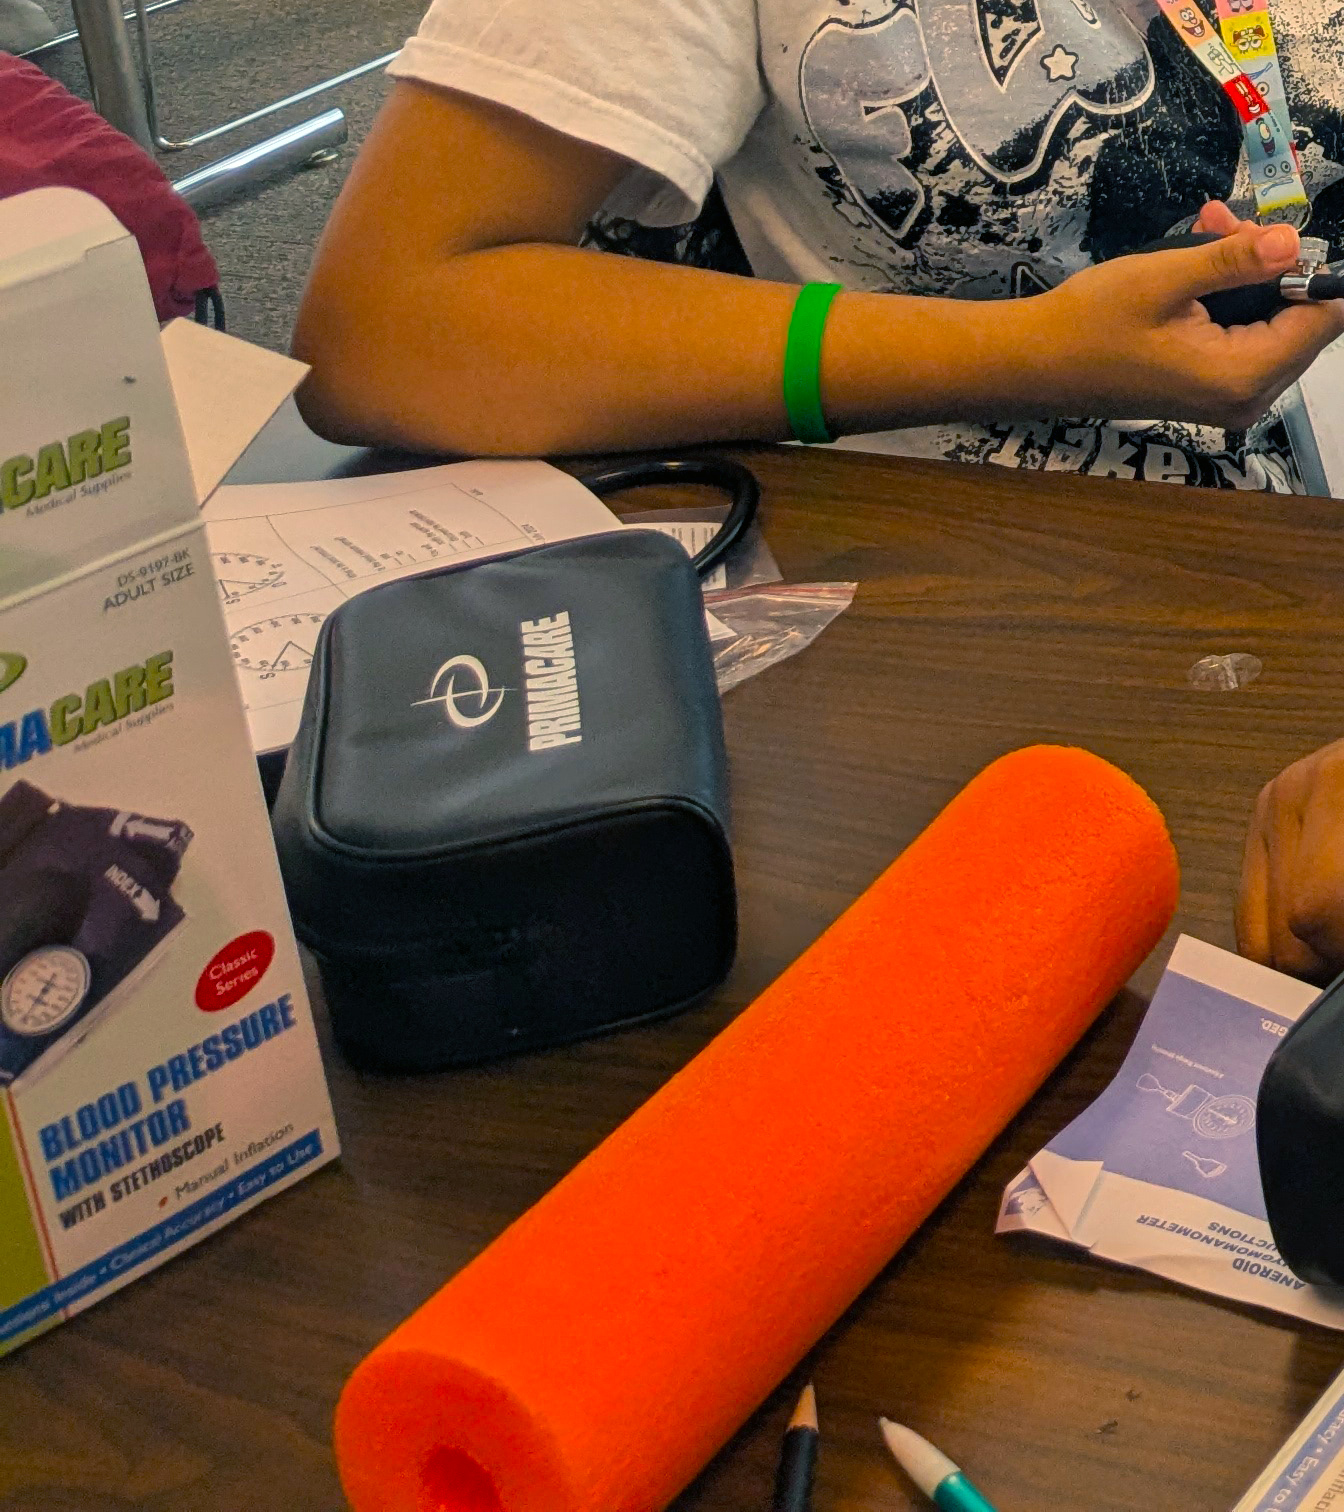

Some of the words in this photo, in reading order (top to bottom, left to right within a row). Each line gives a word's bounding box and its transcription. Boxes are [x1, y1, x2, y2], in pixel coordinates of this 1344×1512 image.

[103, 577, 157, 612] ADULT
[162, 562, 196, 587] SIZE
[521, 611, 582, 751] PRIMACARE
[209, 948, 259, 980] Classic
[215, 966, 259, 996] Series
[38, 1081, 143, 1163] BLOOD
[146, 993, 297, 1104] PRESSURE
[48, 1098, 191, 1204] MONITOR
[174, 1158, 229, 1200] Manual
[233, 1122, 295, 1166] Inflation
[58, 1195, 107, 1232] WITH
[111, 1121, 226, 1204] STETHOSCOPE
[1232, 1256, 1307, 1291] ANEROID
[1274, 1485, 1293, 1504] to
[1288, 1454, 1320, 1488] Easy
